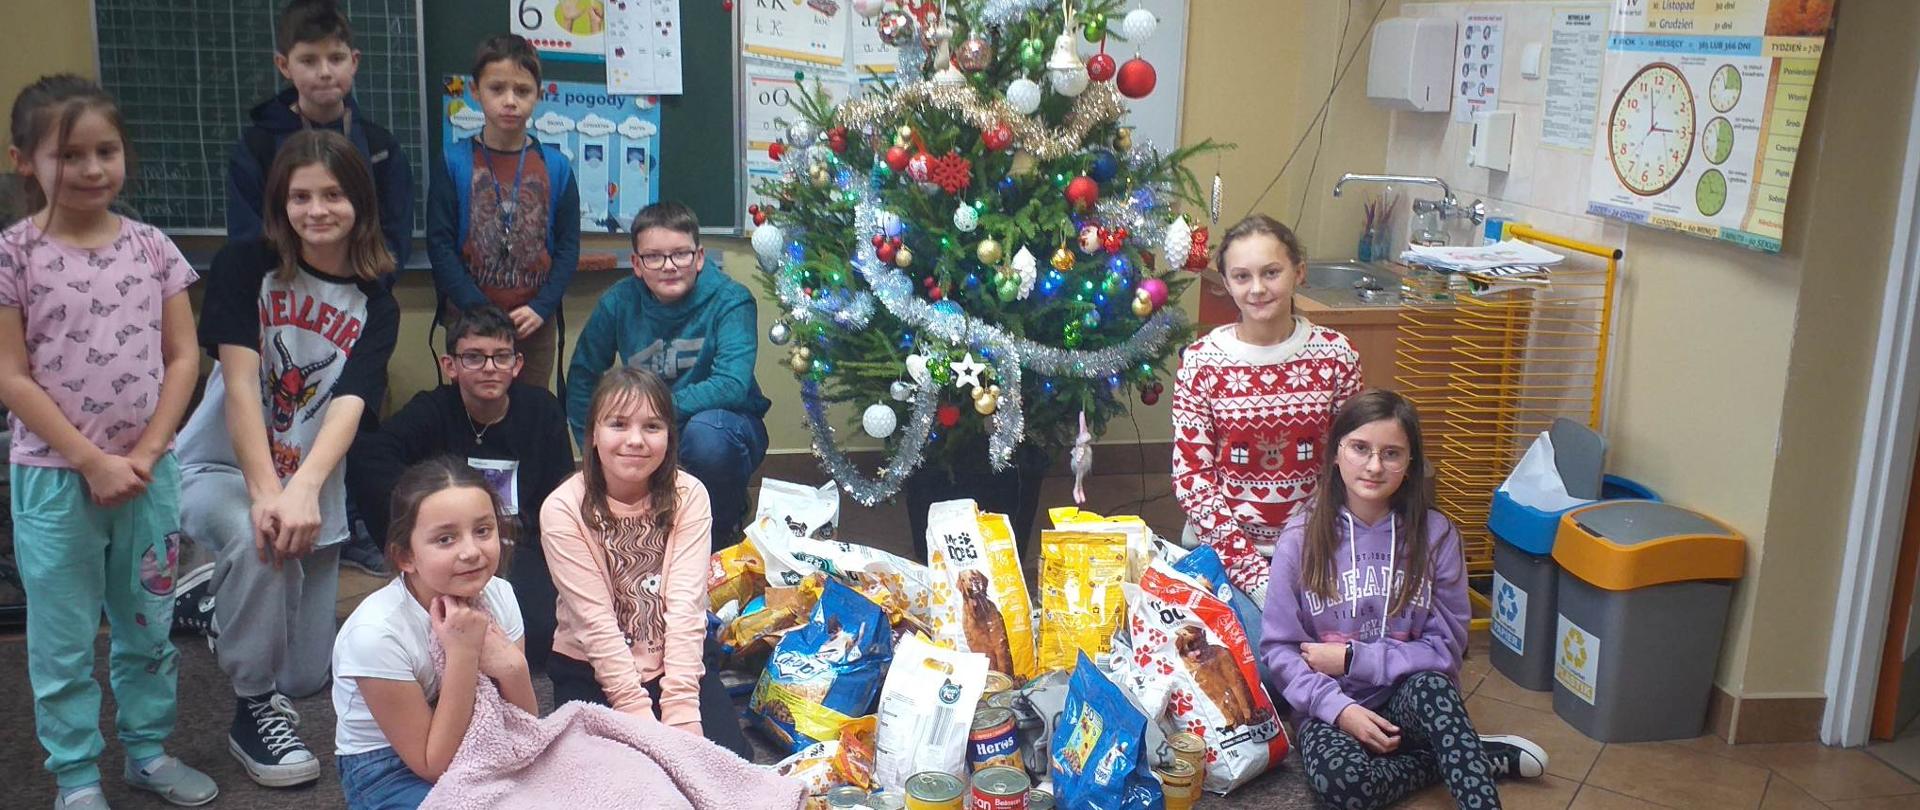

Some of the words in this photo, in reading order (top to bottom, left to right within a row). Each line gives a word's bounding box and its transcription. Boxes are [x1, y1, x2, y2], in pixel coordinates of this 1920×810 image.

[518, 0, 543, 30] 6
[1659, 18, 1693, 29] Grudzień
[1654, 75, 1664, 86] 12
[1639, 82, 1648, 93] 11
[1671, 84, 1676, 93] 1
[565, 93, 627, 109] pogody
[1627, 98, 1638, 110] 10
[1679, 102, 1686, 113] 2
[1619, 119, 1627, 132] 9
[1679, 126, 1687, 140] 3
[1620, 145, 1628, 156] 8
[1672, 150, 1679, 163] 4
[1627, 160, 1635, 173] 7
[1657, 167, 1664, 177] 5
[1640, 170, 1649, 183] 6
